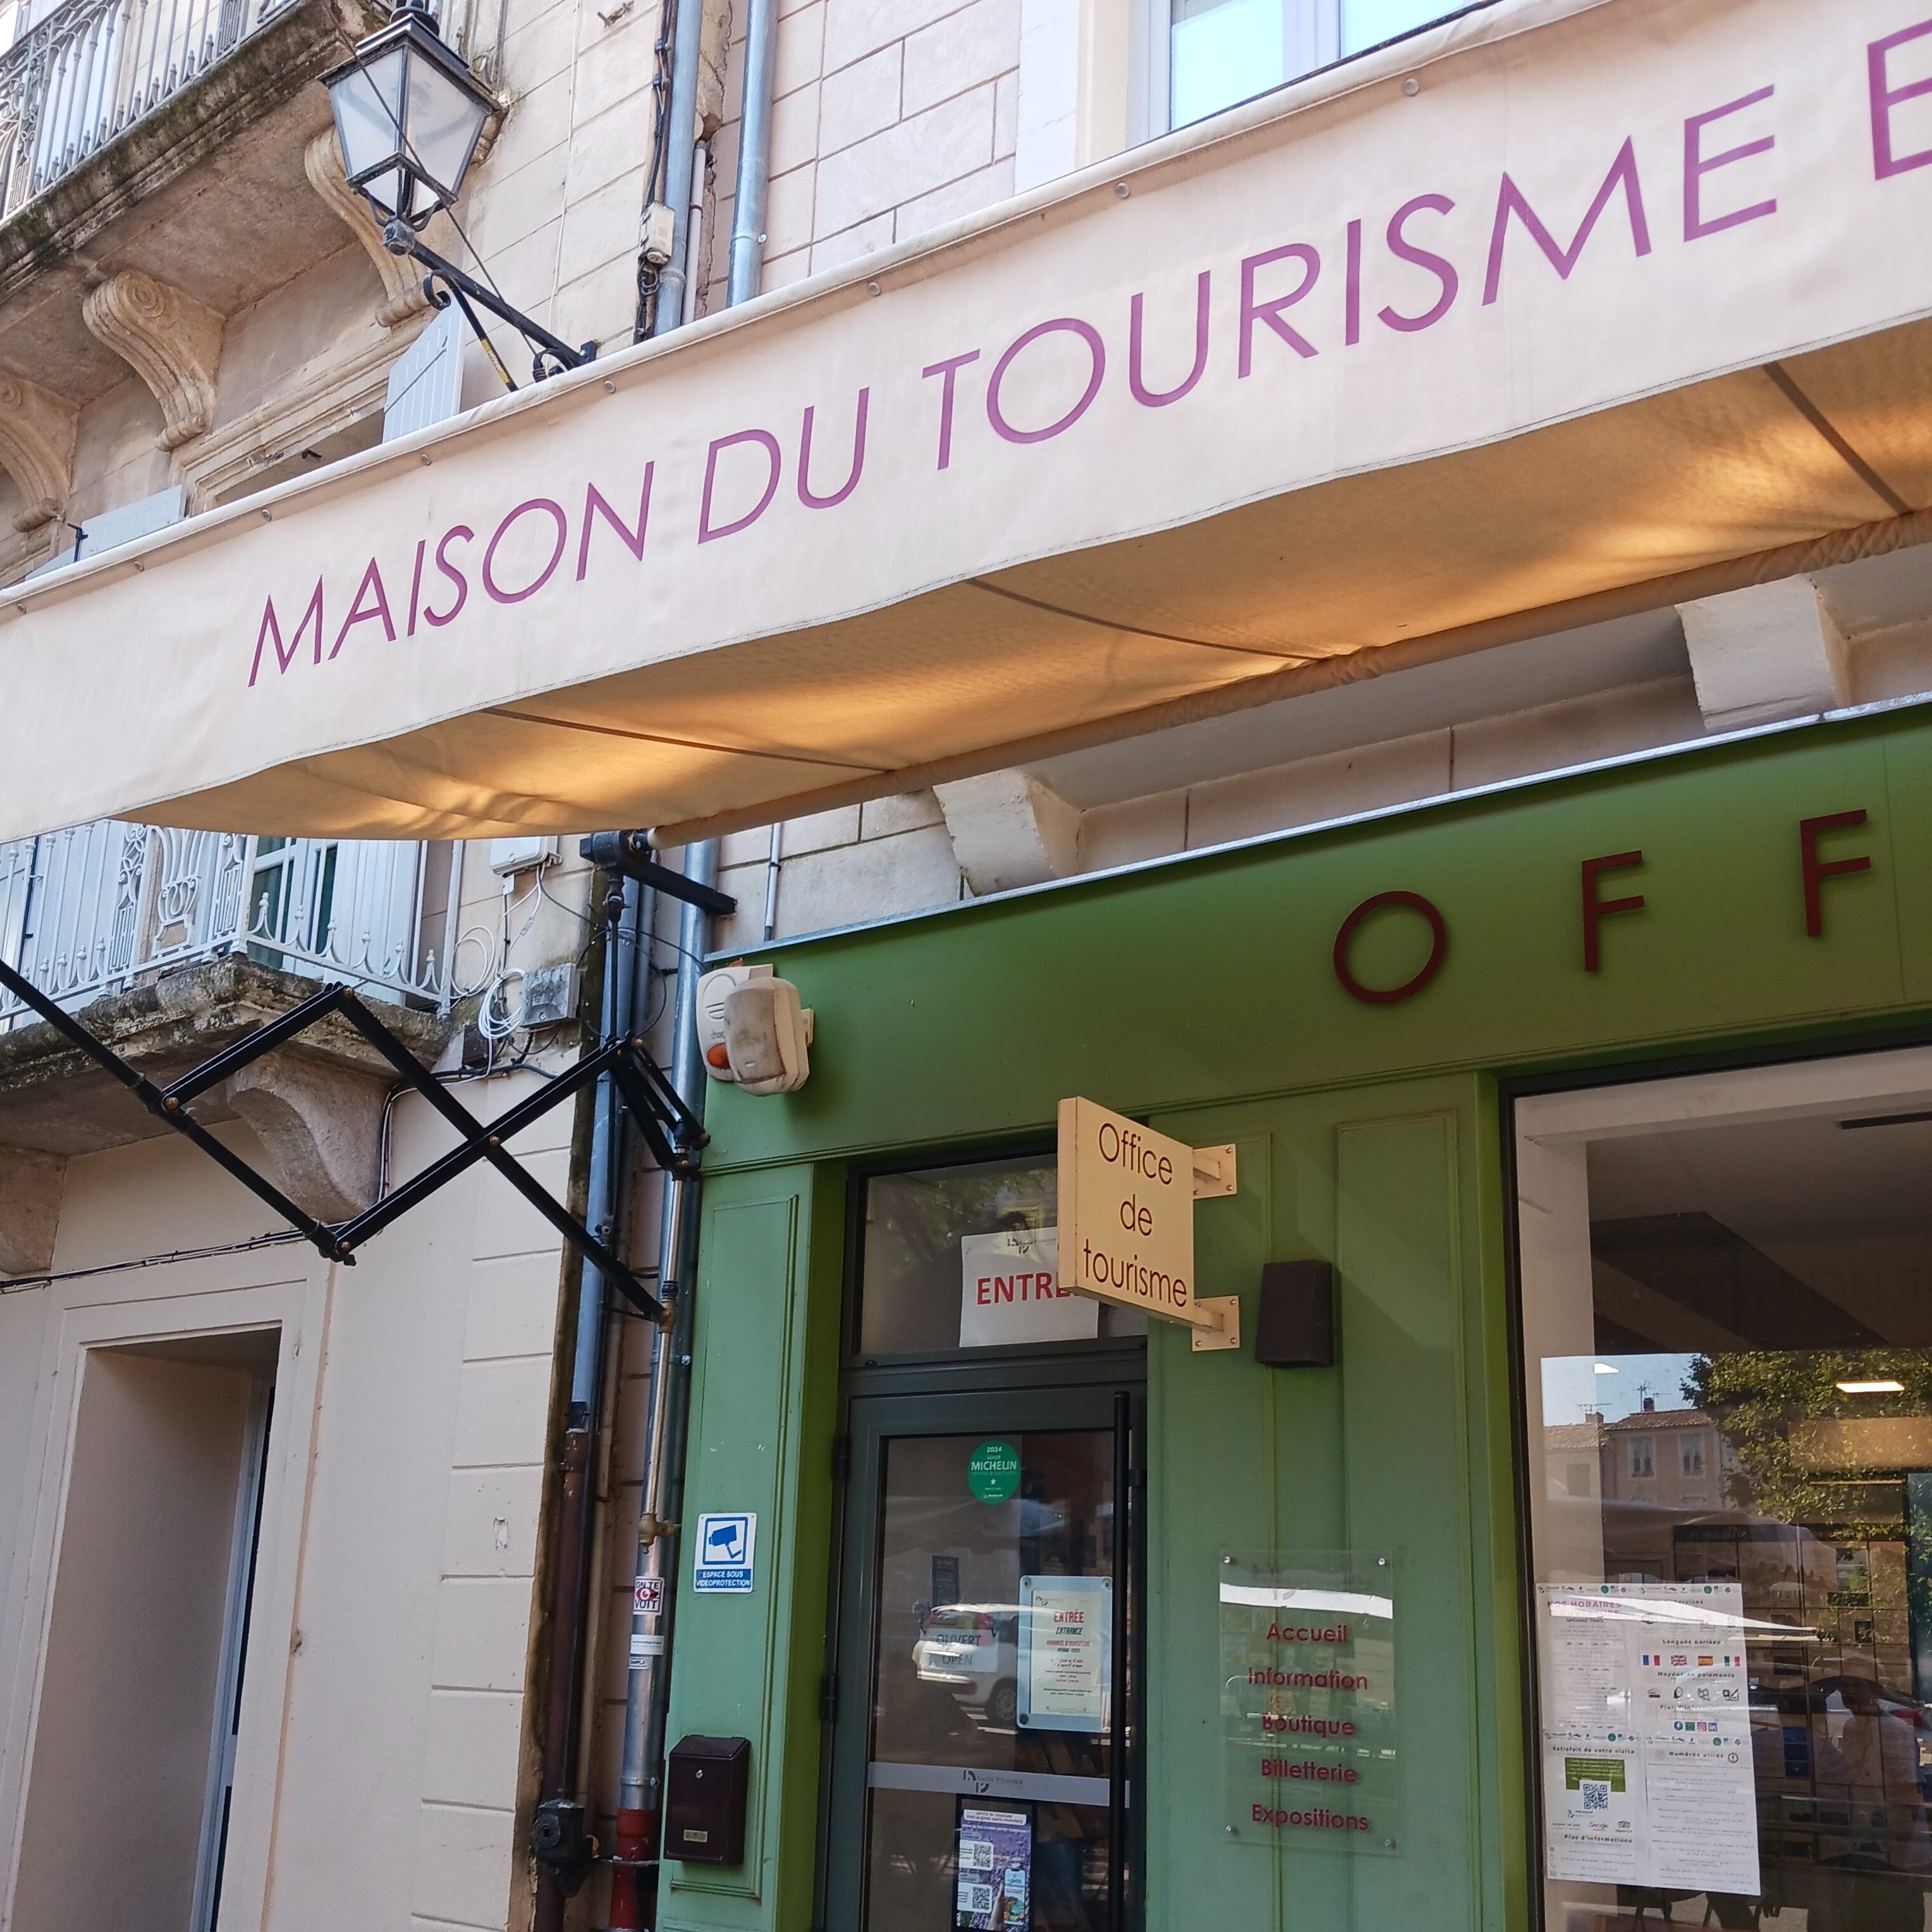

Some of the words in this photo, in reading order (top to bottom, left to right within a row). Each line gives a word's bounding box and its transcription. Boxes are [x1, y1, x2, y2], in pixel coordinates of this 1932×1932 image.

[248, 462, 654, 687] MAISON
[698, 389, 869, 544] DU
[922, 86, 1776, 470] TOURISME
[1333, 809, 1872, 1006] OFF
[1099, 1123, 1173, 1185] Office
[1120, 1194, 1152, 1236] de
[1083, 1238, 1187, 1307] tourisme
[970, 1460, 1017, 1471] MICHELIN
[649, 1581, 659, 1589] TE
[634, 1599, 657, 1610] VOIT
[1053, 1608, 1084, 1623] ENTRÉE
[936, 1634, 982, 1646] OUVERT
[1266, 1622, 1348, 1644] Accueil
[942, 1653, 973, 1665] OPEN
[1247, 1666, 1369, 1690] Information
[1261, 1712, 1355, 1739] Boutique
[1261, 1758, 1357, 1783] Billetterie
[1251, 1803, 1369, 1831] Expositions
